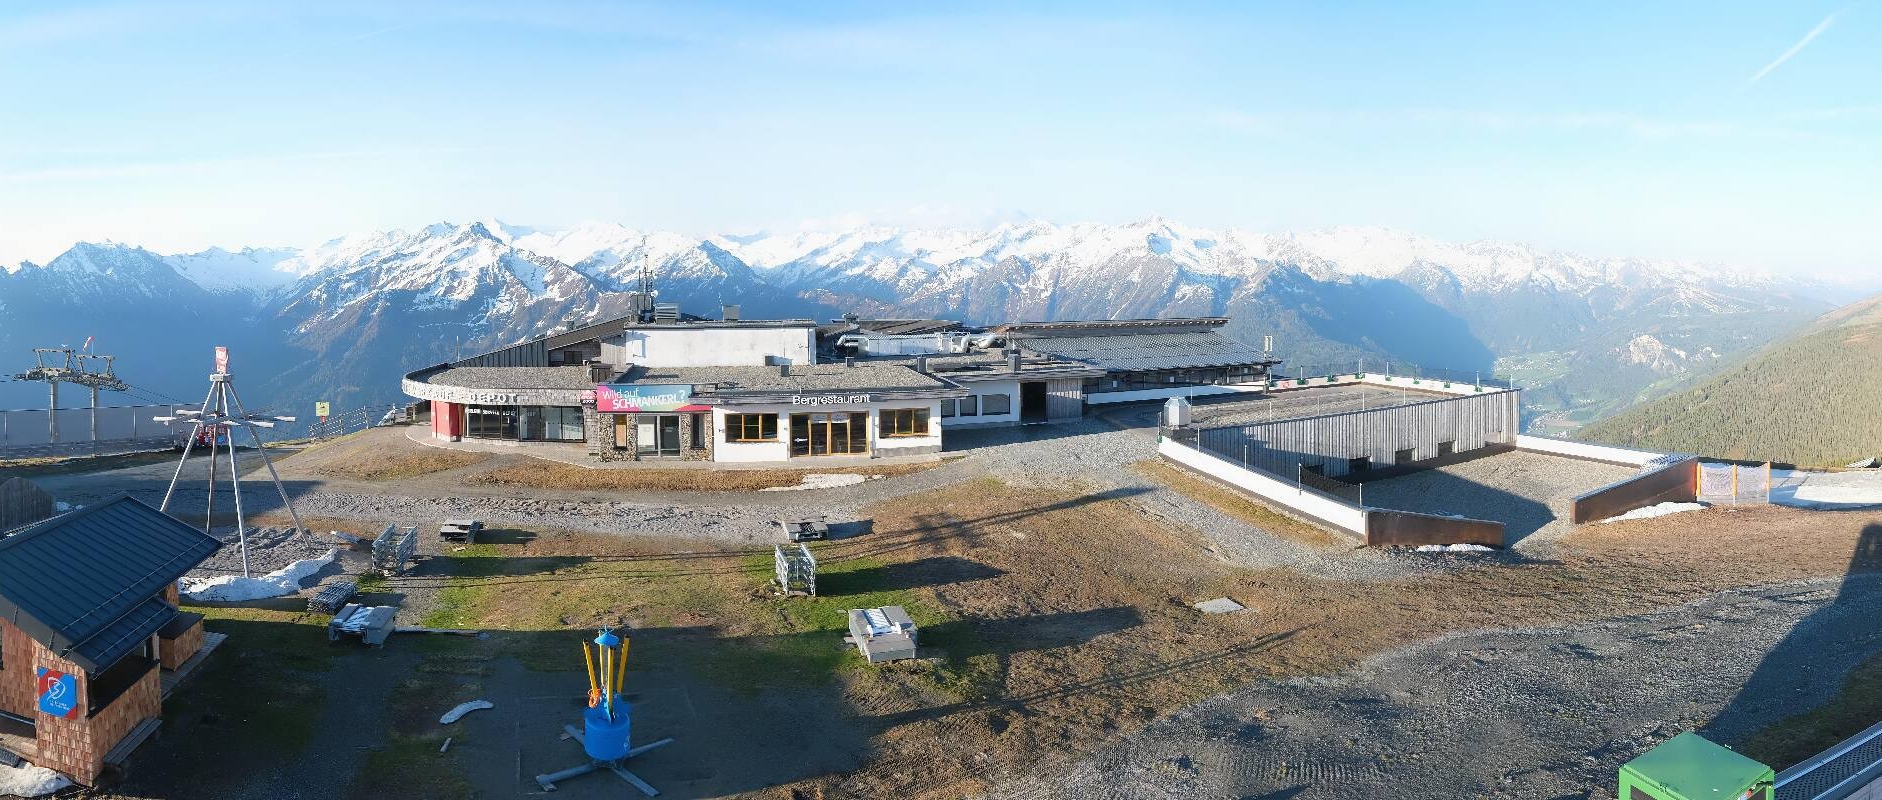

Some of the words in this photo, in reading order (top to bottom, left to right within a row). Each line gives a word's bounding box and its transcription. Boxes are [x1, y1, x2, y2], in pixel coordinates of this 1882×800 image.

[469, 392, 519, 403] DEPOT
[602, 389, 622, 400] Wild
[624, 387, 640, 398] auf
[612, 389, 686, 410] SCHMANKERL?
[792, 394, 871, 406] Bergrestaurant
